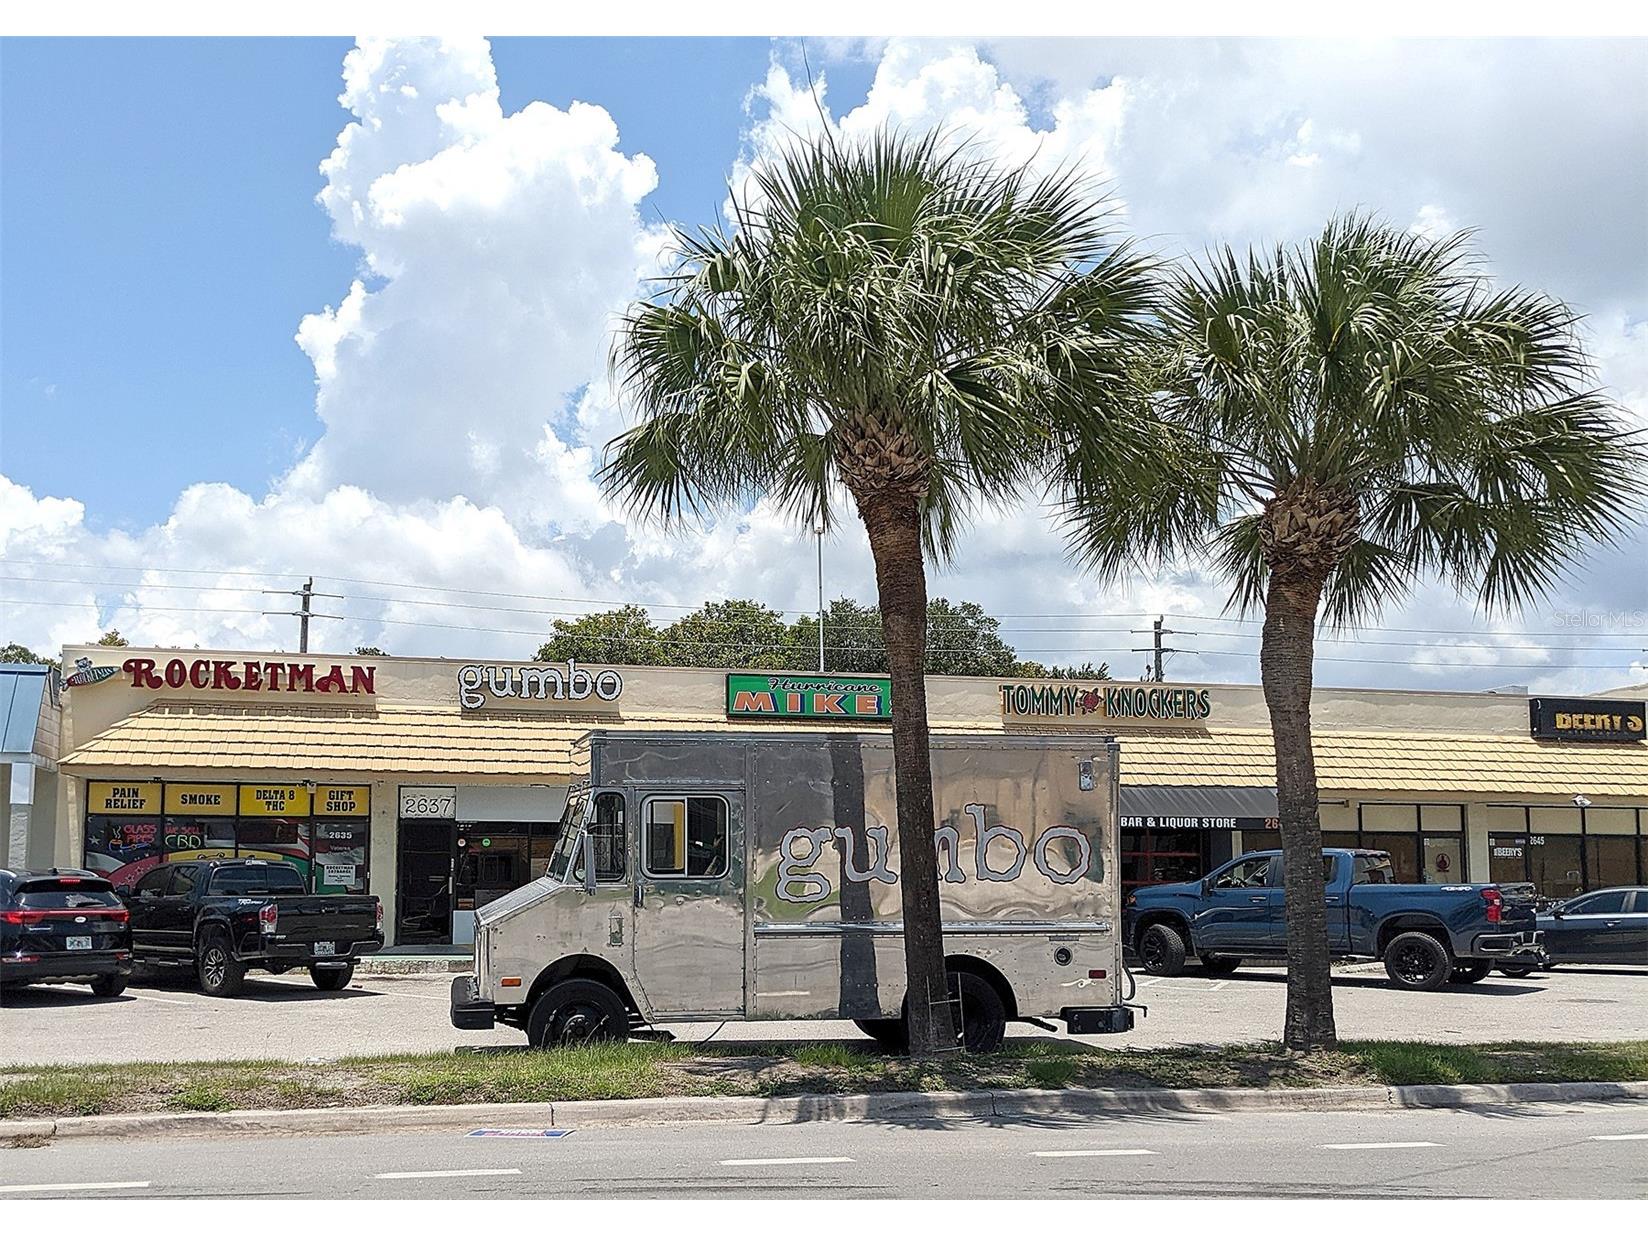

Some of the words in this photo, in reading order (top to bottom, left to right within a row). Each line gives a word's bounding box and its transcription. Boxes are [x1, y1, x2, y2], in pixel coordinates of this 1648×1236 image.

[123, 658, 377, 695] ROCKETMAN
[457, 658, 624, 709] gumbo
[768, 677, 882, 692] Hurricane
[733, 691, 893, 715] MIKE
[1001, 685, 1079, 716] TOMMY
[1104, 688, 1211, 719] KNOCKERS
[112, 788, 139, 798] PAIN
[255, 790, 286, 800] DELTA
[288, 790, 295, 800] 8
[328, 790, 354, 801] GIFT
[105, 799, 146, 809] RELIEF
[180, 794, 221, 805] SMOKE
[265, 801, 285, 811] THC
[326, 801, 356, 812] SHOP
[405, 798, 452, 814] 2637
[1120, 817, 1143, 827] BAR
[1146, 817, 1156, 828] &
[1159, 817, 1199, 829] LIQUOR
[1202, 818, 1237, 828] STORE
[329, 831, 353, 839] 2635
[165, 834, 201, 849] CBD
